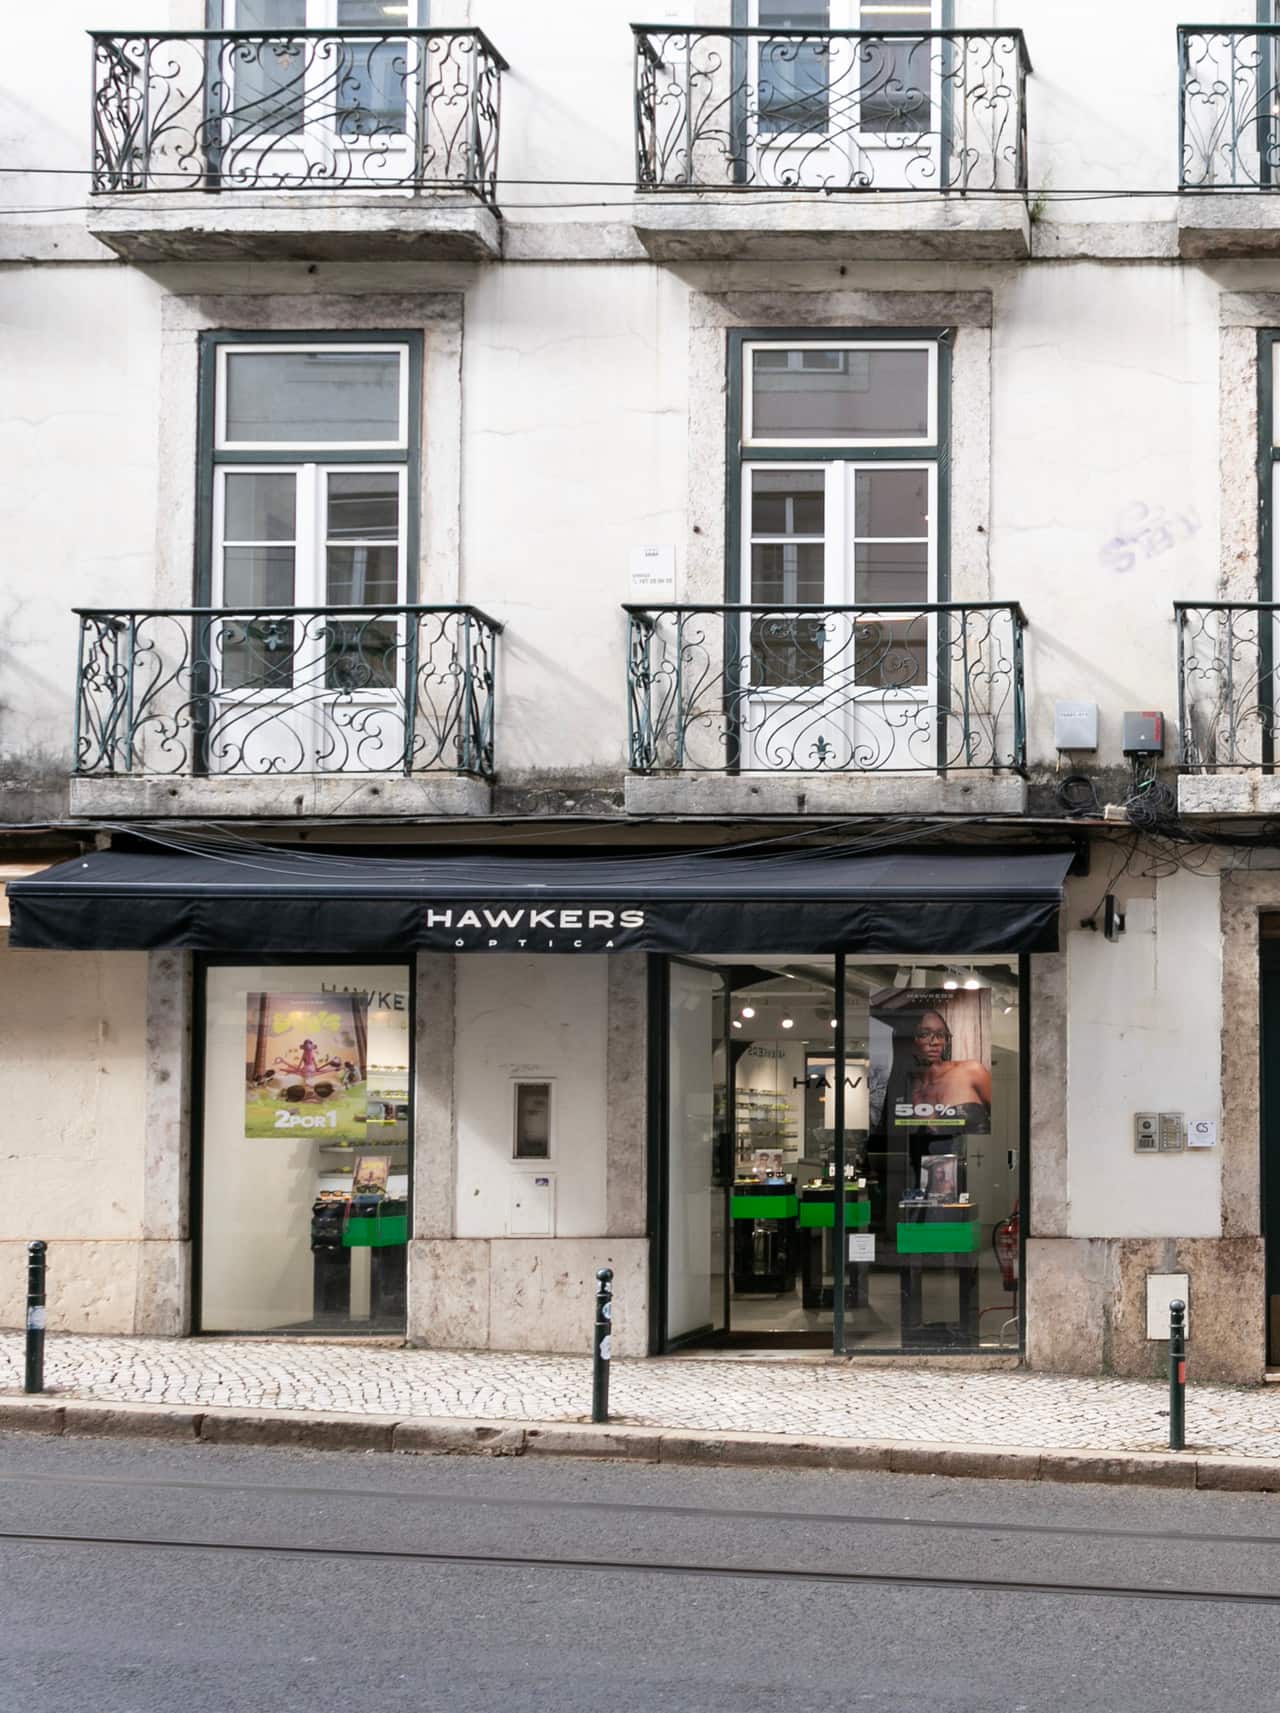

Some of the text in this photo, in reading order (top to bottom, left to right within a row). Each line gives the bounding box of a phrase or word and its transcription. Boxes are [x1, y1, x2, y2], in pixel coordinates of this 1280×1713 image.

[427, 909, 645, 928] HAWKERS
[455, 937, 614, 948] ÓPTICA
[894, 1103, 956, 1117] 50%
